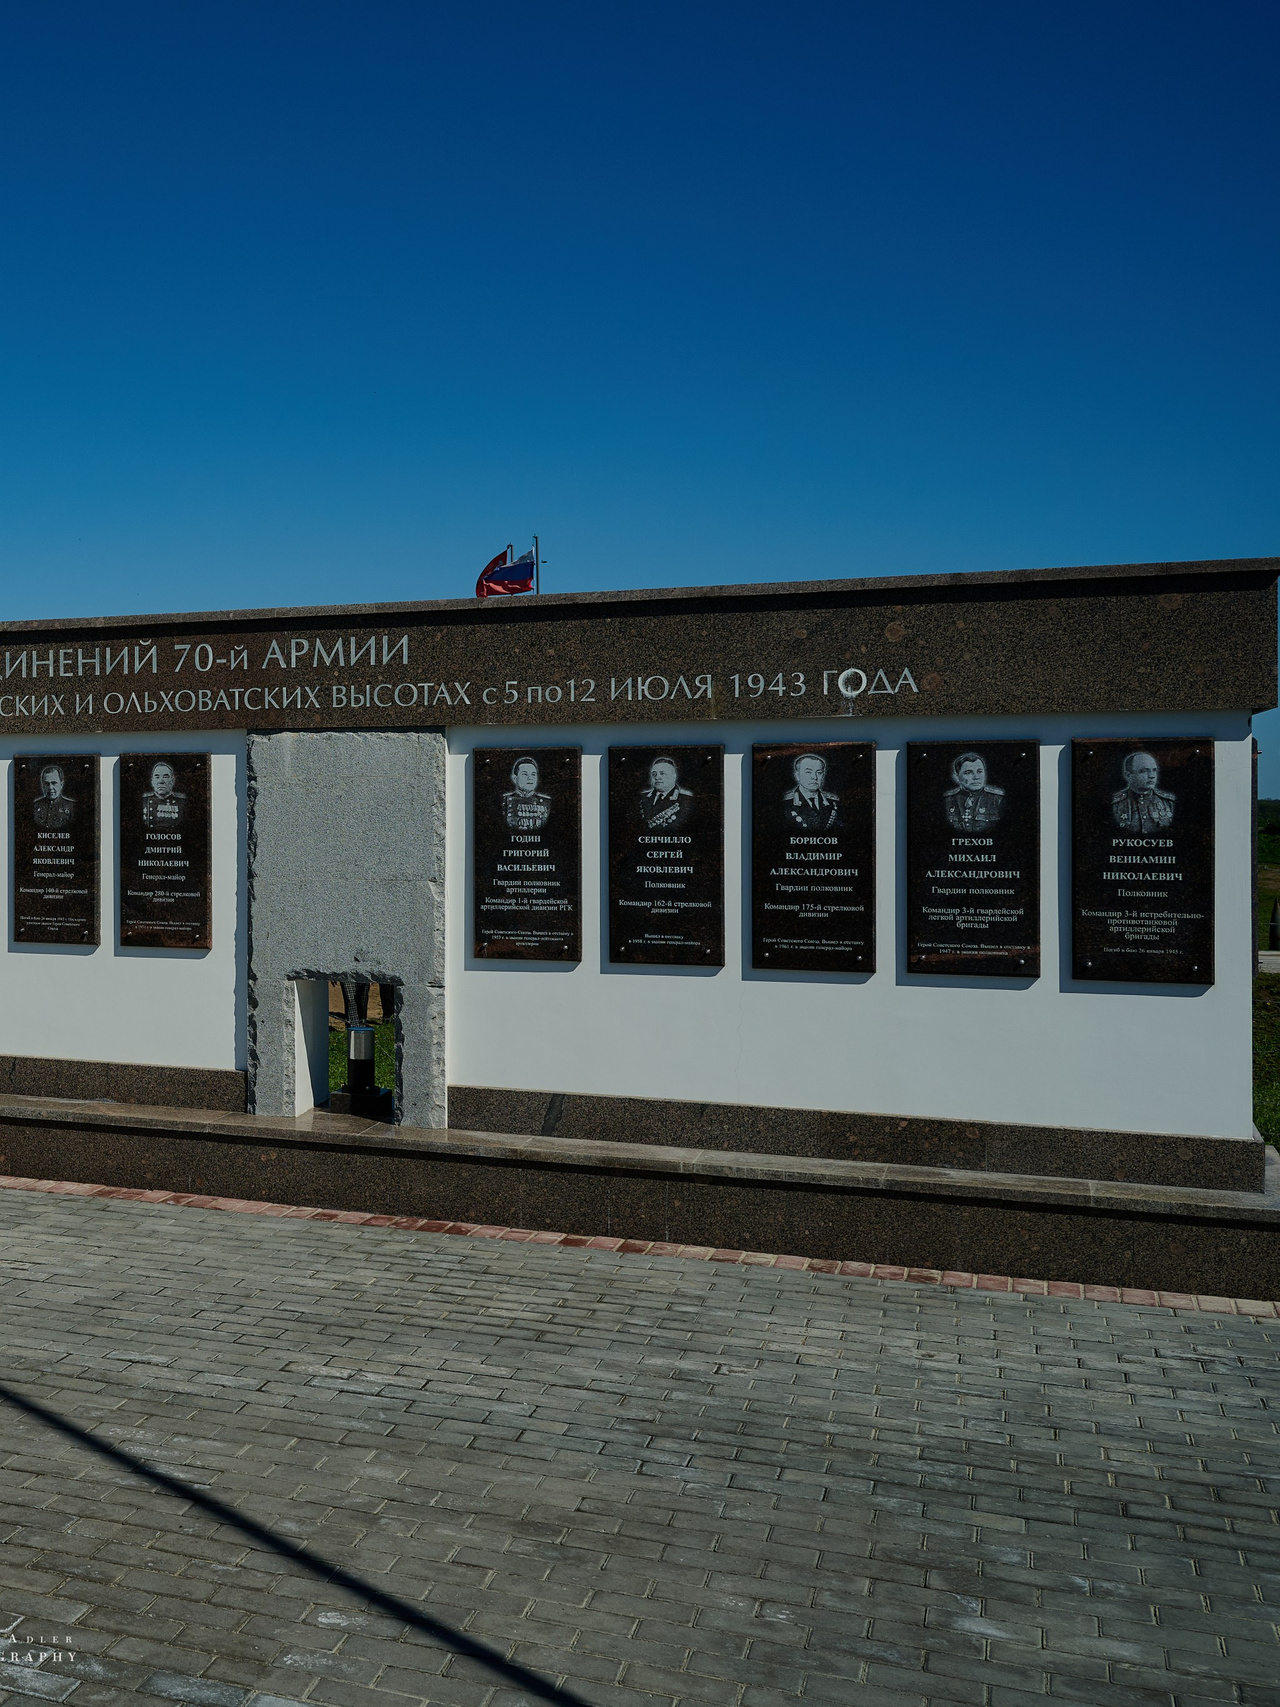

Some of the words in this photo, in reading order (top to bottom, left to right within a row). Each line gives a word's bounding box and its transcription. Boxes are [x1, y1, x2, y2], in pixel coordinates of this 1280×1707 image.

[173, 643, 249, 673] 70-й
[261, 634, 409, 670] АРМИИ
[75, 693, 93, 715] И
[103, 685, 322, 714] ОЛЬХОВАТСКИХ
[331, 681, 471, 709] ВЫСОТАХ
[482, 687, 497, 705] с
[610, 674, 712, 701] ИЮЛЯ
[729, 672, 806, 699] 1943
[823, 667, 920, 696] ГОДА
[37, 832, 71, 840] КИСЕЛЕВ
[145, 833, 182, 841] ГОЛОСОВ
[511, 835, 541, 844] ГОДИН
[637, 835, 692, 844] СЕНЧИЛЛО
[789, 836, 838, 845] БОРИСОВ
[951, 838, 994, 846] ГРЕХОВ
[1112, 838, 1174, 848] РУКОСУЕВ
[33, 845, 75, 853] АЛЕКСАНДР
[144, 846, 182, 855] ДМИТРИЙ
[503, 849, 550, 857] ГРИГОРИЙ
[646, 850, 683, 859] СЕРГЕЙ
[785, 852, 843, 861] ВЛАДИМИР
[948, 854, 997, 862] МИХАИЛ
[32, 858, 75, 866] ЯКОВЛЕВИЧ
[137, 860, 190, 868] НИКОЛАЕВИЧ
[1109, 855, 1176, 864] ВЕНИАМИН
[497, 864, 556, 872] ВАСИЛЬЕВИЧ
[635, 865, 694, 874] ЯКОВЛЕВИЧ
[769, 867, 859, 877] АЛЕКСАНДРОВИЧ
[33, 871, 75, 880] Генерал-майор
[142, 873, 186, 882] Генерал-майор
[925, 870, 1021, 879] АЛЕКСАНДРОВИЧ
[1102, 872, 1183, 881] НИКОЛАЕВИЧ
[492, 878, 522, 887] Гвардии
[644, 880, 686, 889] Полковник
[19, 887, 45, 895] Командир
[506, 887, 547, 895] артиллерии
[775, 883, 809, 892] Гвардии
[931, 886, 967, 896] Гвардии
[127, 889, 154, 897] Командир
[170, 891, 201, 899] стрелковой
[1117, 888, 1169, 898] Полковник
[485, 897, 517, 906] Командир
[529, 898, 569, 906] гвардейской
[618, 899, 652, 909] Командир
[673, 901, 712, 909] стрелковой
[764, 902, 800, 911] Командир
[823, 904, 864, 912] стрелковой
[922, 906, 961, 915] Командир
[976, 907, 1025, 915] гвардейской
[928, 914, 954, 922] легкой
[955, 914, 1018, 922] артиллерийской
[1081, 909, 1122, 919] Командир
[1124, 910, 1138, 918] 3-й
[1140, 911, 1205, 920] истребительно-
[956, 921, 990, 930] бригады
[1107, 918, 1178, 926] противотанковой
[1109, 925, 1175, 934] артиллерийской
[1124, 932, 1160, 941] бригады
